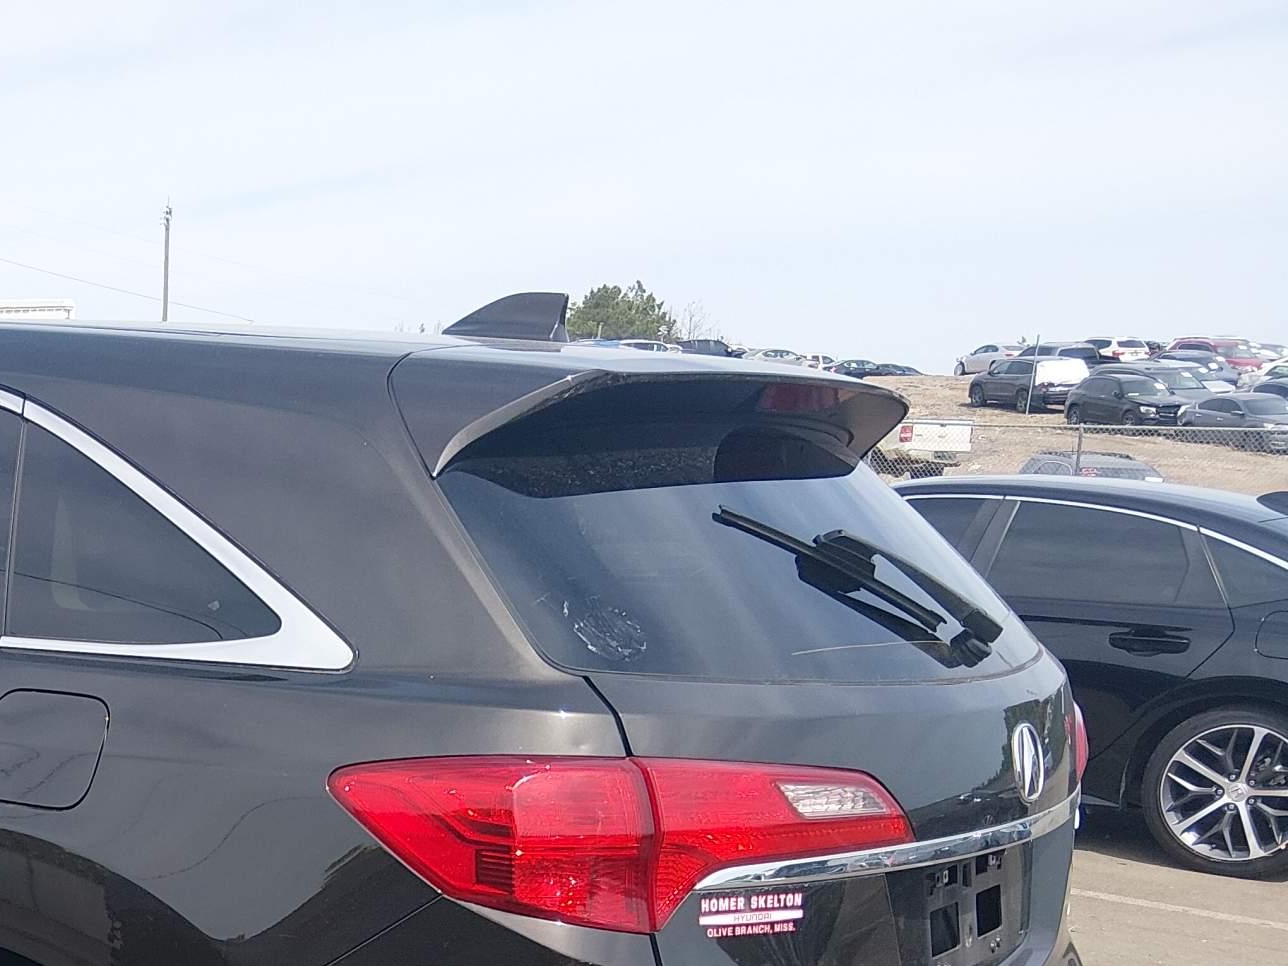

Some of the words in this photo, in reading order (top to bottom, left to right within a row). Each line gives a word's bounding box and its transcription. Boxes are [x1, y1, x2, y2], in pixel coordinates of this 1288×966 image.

[701, 897, 745, 912] HOMER
[751, 893, 803, 909] SKELTON
[733, 914, 772, 922] HYUNDAI
[707, 927, 733, 937] OLIVE
[735, 924, 773, 935] BRANCH,
[774, 922, 796, 932] MISS.
